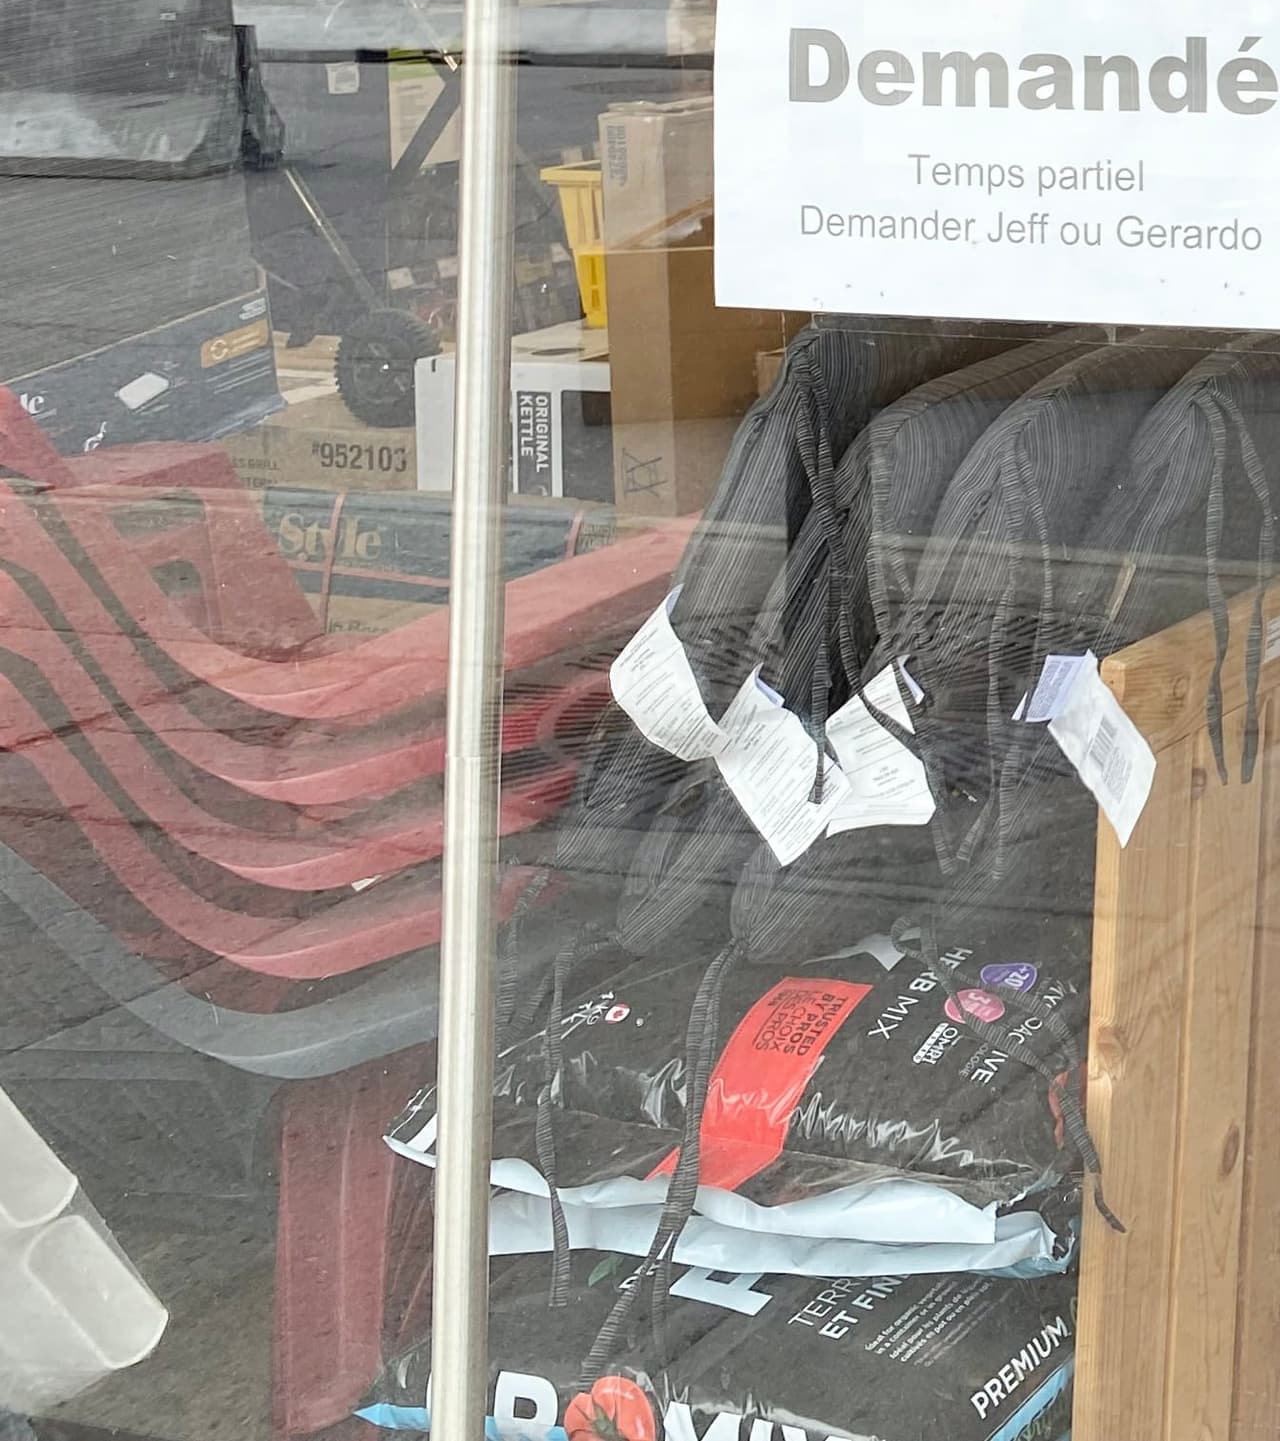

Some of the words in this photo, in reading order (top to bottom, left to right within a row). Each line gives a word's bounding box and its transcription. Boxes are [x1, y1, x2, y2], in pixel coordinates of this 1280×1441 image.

[788, 28, 1279, 115] Demandé
[908, 154, 1025, 195] Temps
[1037, 158, 1145, 196] partiel
[800, 205, 976, 242] Demander
[986, 211, 1050, 245] Jeff
[1060, 220, 1102, 247] ou
[1116, 215, 1262, 252] Gerardo
[518, 394, 535, 457] KETTLE
[534, 394, 550, 473] ORIGINAL
[754, 1011, 789, 1053] PROS
[768, 1006, 808, 1053] CHOIX
[781, 1012, 819, 1056] PROS
[794, 995, 849, 1058] TRUSTED
[866, 989, 916, 1040] MIX
[787, 1276, 866, 1327] TERR
[819, 1310, 859, 1340] ET
[852, 1274, 911, 1310] FIN
[970, 1316, 1072, 1419] PREMIUM
